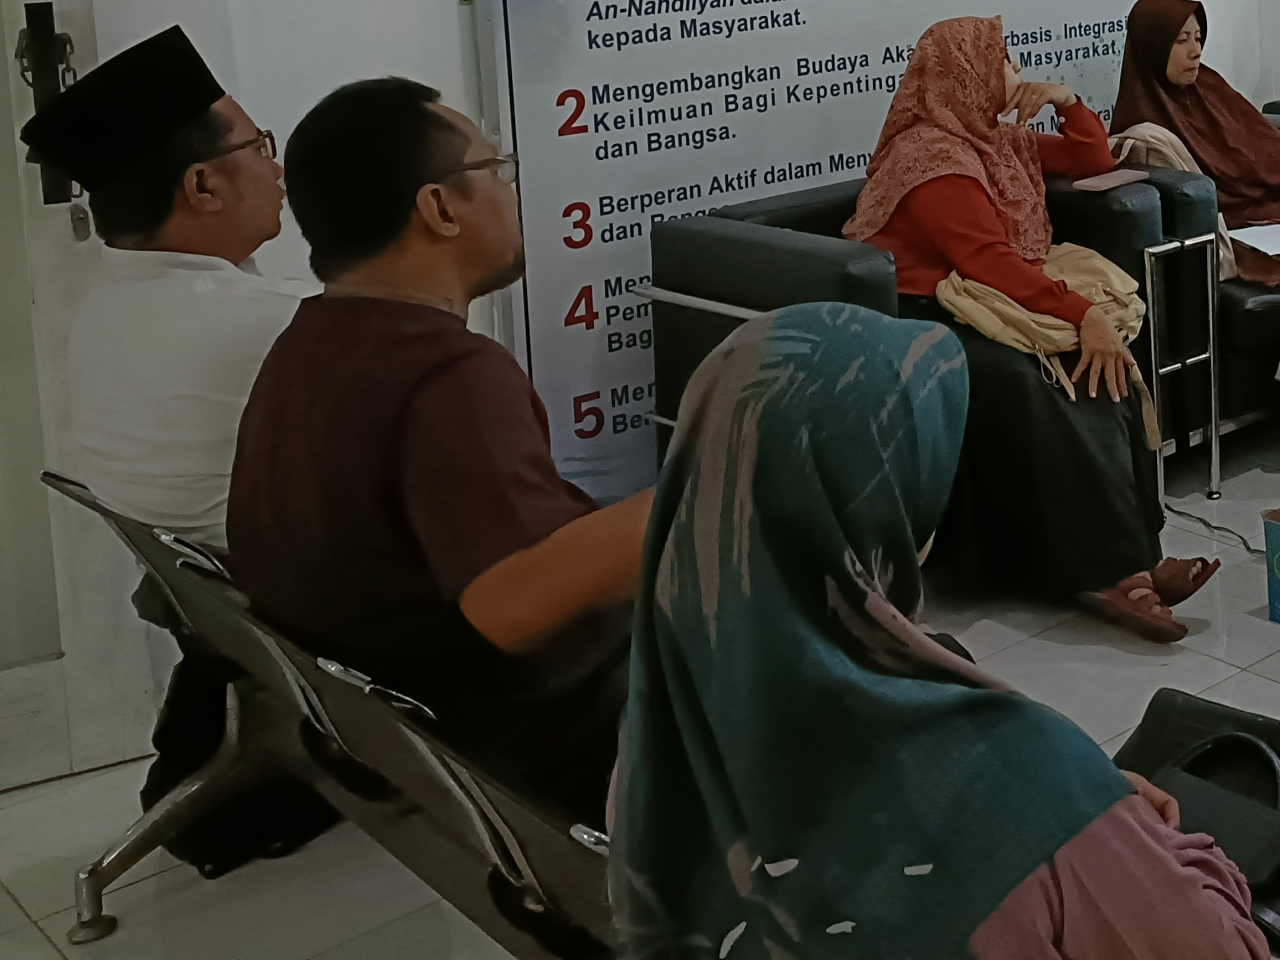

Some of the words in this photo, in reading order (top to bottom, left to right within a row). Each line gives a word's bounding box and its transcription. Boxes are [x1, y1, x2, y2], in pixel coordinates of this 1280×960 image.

[587, 23, 672, 51] kepada
[680, 8, 807, 39] Masyarakat.
[591, 65, 781, 105] Mengembangkan
[796, 53, 869, 77] Budaya
[1004, 26, 1052, 47] rbasis
[1064, 15, 1128, 39] Integrasi
[593, 101, 713, 134] Keilmuan
[724, 88, 776, 114] Bagi
[787, 74, 904, 104] Kepenting
[1020, 39, 1120, 68] Masyarakat,
[555, 89, 589, 137] 2
[595, 139, 638, 161] dan
[647, 124, 736, 153] Bangsa.
[599, 183, 701, 216] Berperan
[708, 169, 757, 196] Aktif
[763, 158, 823, 186] dalam
[561, 201, 593, 249] 3
[600, 222, 642, 243] dan
[564, 284, 599, 330] 4
[607, 329, 652, 353] Bag
[573, 391, 604, 439] 5
